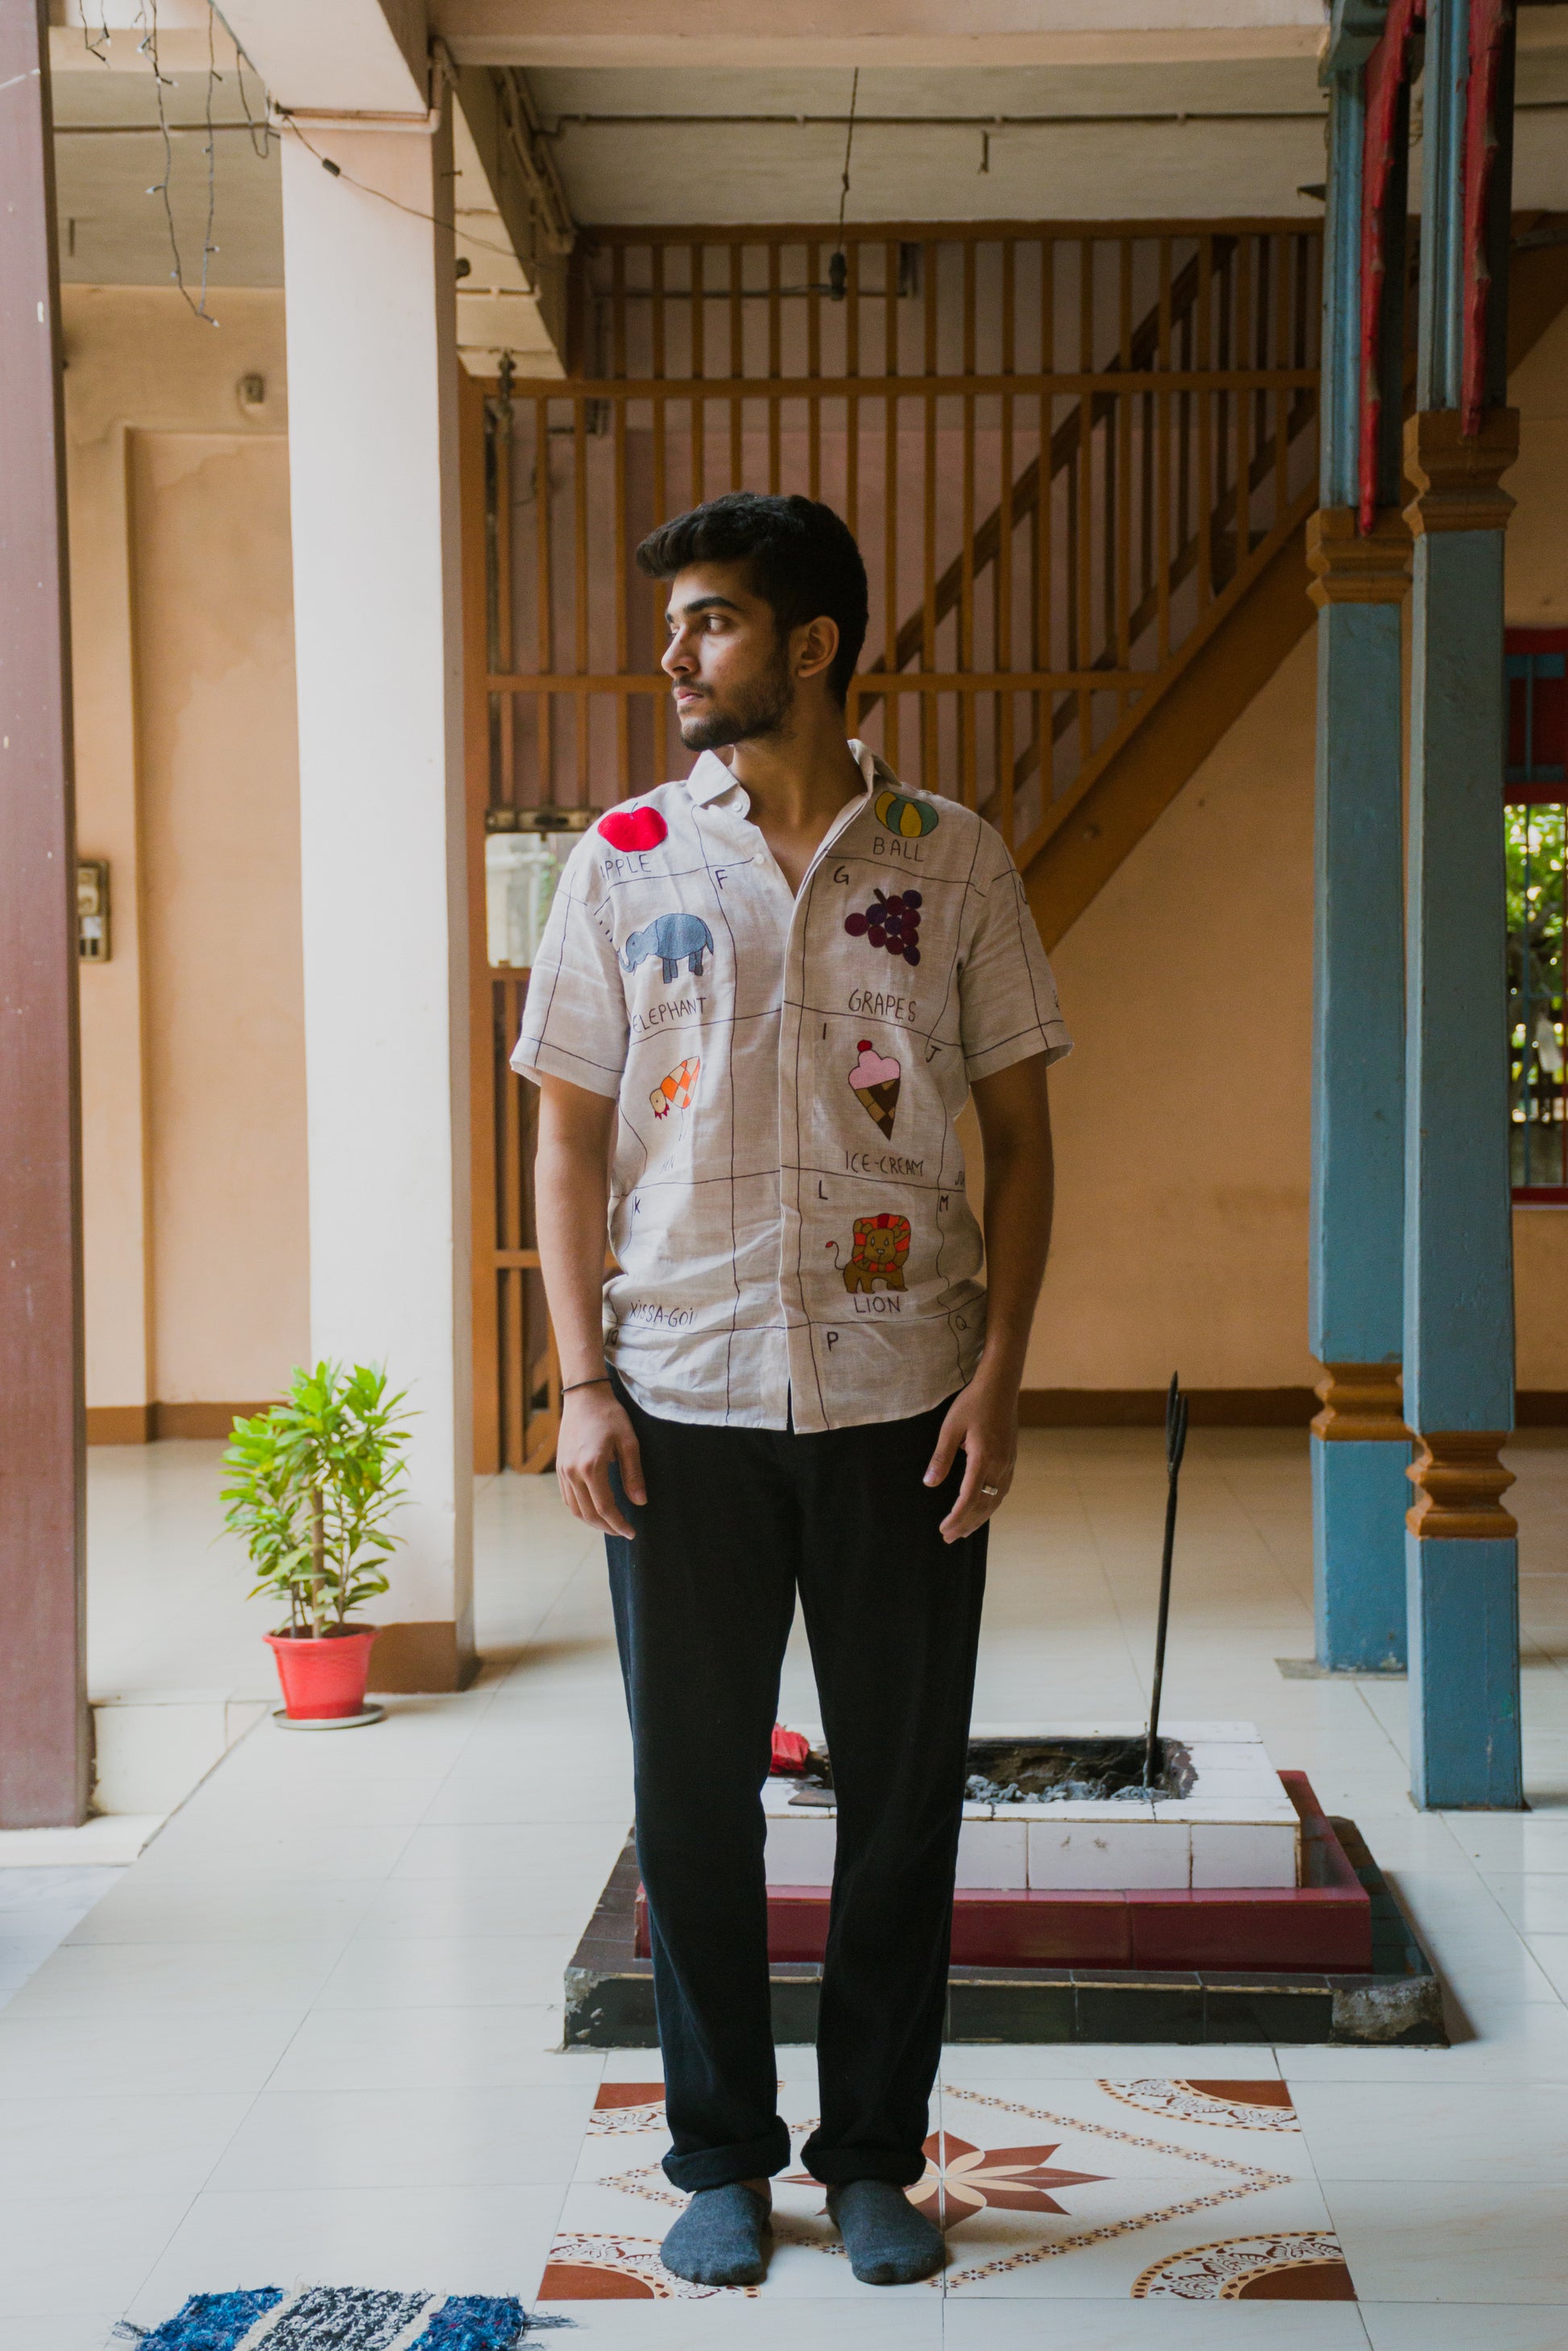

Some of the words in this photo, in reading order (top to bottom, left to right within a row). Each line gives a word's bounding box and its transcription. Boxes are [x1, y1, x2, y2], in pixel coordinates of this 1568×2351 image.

[873, 837, 924, 863] BALL
[715, 869, 728, 889] F
[833, 865, 849, 885] G
[632, 997, 707, 1033] ELEPHANT
[848, 988, 916, 1022] GRAPES
[925, 1045, 942, 1063] J
[845, 1150, 924, 1177] ICE-CREAM
[818, 1180, 828, 1200] L
[634, 1196, 641, 1215] K
[940, 1194, 949, 1213] M
[854, 1295, 901, 1313] LION
[956, 1315, 972, 1330] Q
[827, 1331, 839, 1352] P
